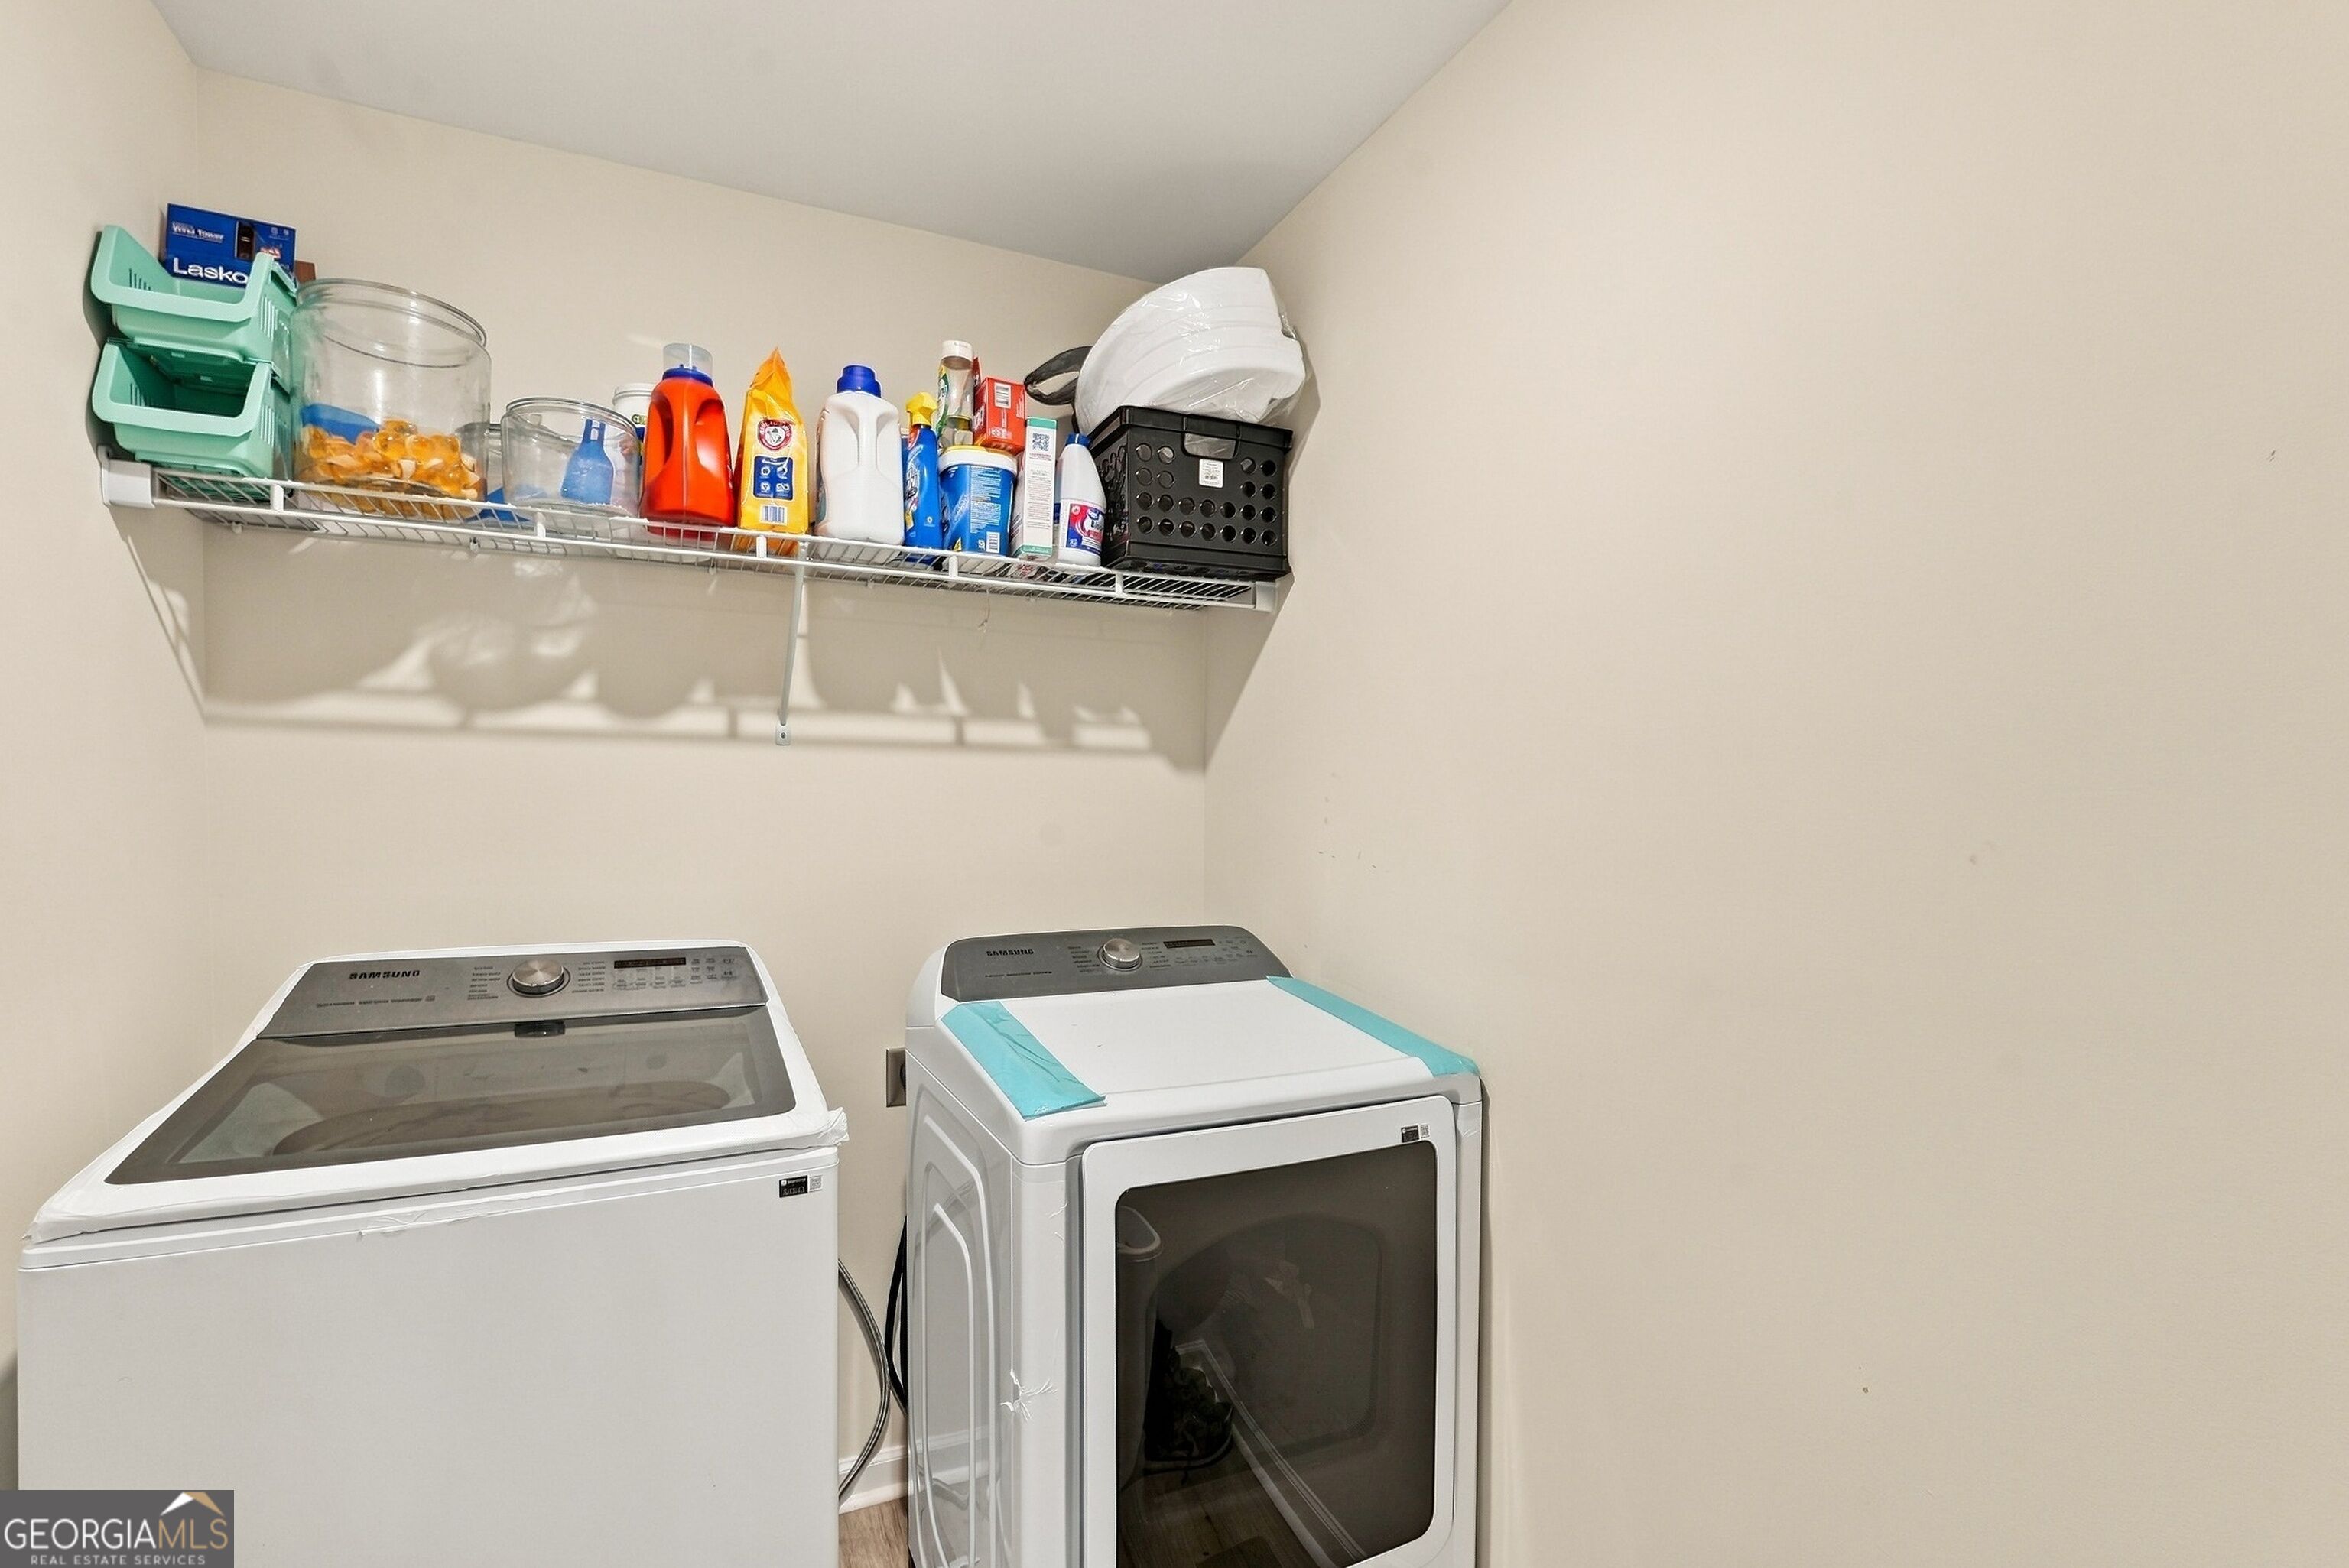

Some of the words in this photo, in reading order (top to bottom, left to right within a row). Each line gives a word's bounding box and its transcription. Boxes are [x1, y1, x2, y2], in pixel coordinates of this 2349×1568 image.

[173, 257, 249, 284] Lasko
[986, 948, 1034, 956] SAMSUNG
[349, 969, 421, 980] SAMSUNG
